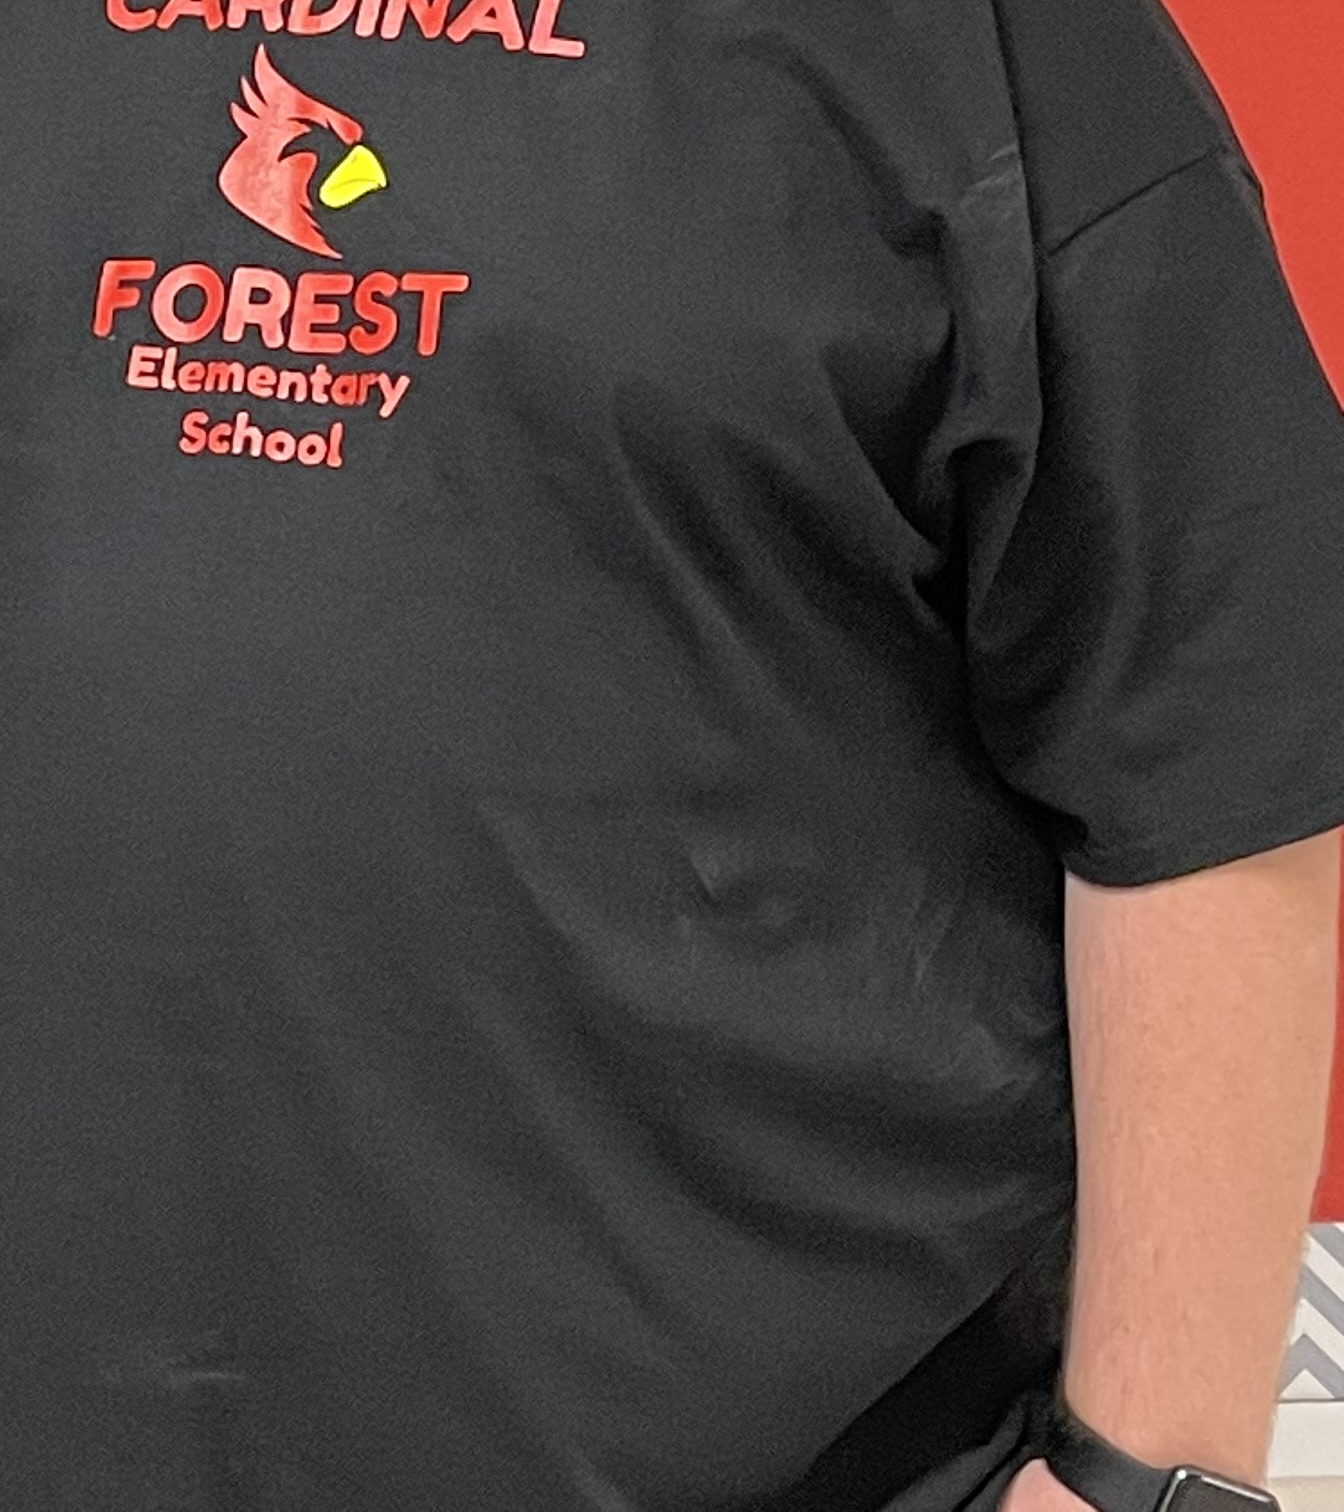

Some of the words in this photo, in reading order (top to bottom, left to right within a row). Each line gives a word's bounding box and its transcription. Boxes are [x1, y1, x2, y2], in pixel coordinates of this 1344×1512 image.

[92, 259, 469, 357] FOREST
[126, 345, 410, 418] Elementary
[179, 410, 343, 468] School
